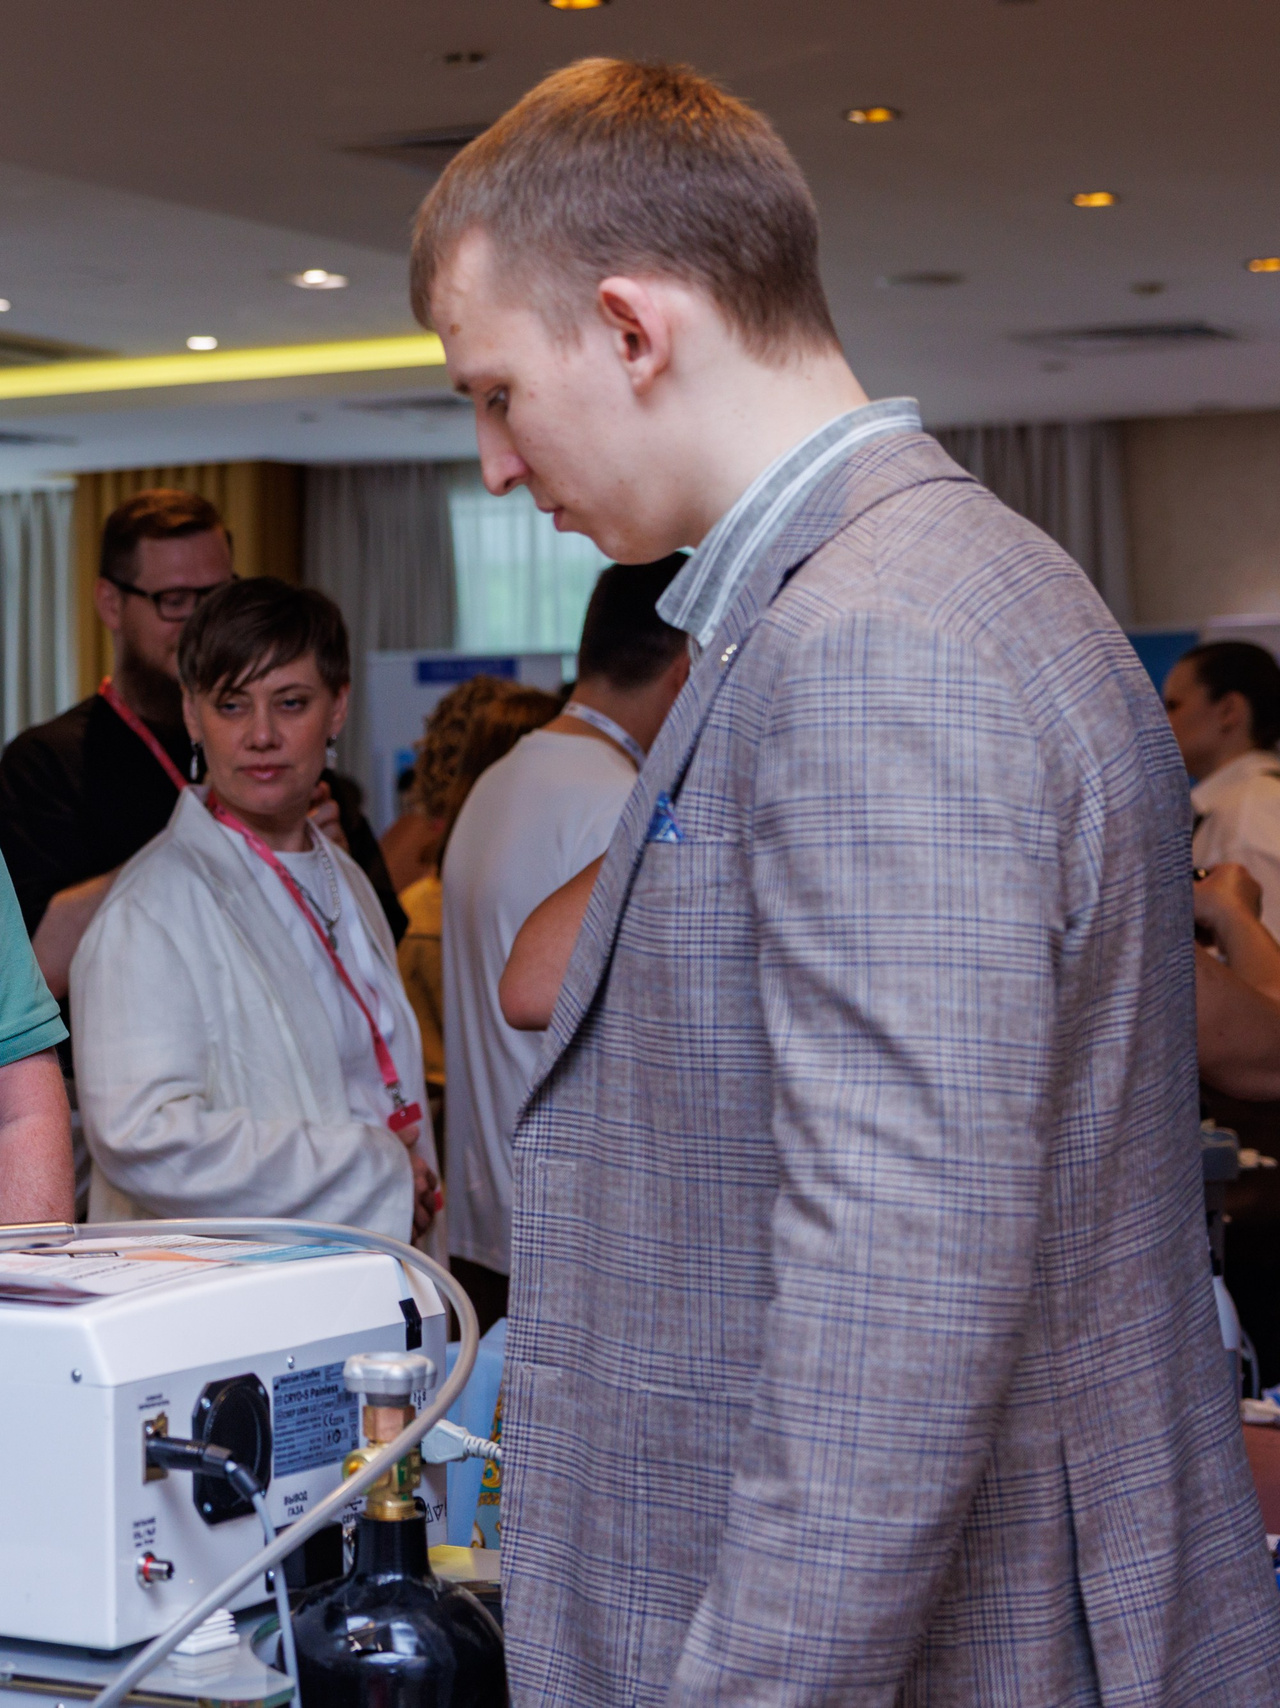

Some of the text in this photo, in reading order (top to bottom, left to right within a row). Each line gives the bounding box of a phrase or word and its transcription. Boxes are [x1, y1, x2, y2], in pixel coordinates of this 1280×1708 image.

[283, 1384, 339, 1405] CRYO-S Painless
[284, 1490, 308, 1505] ВЫВОД
